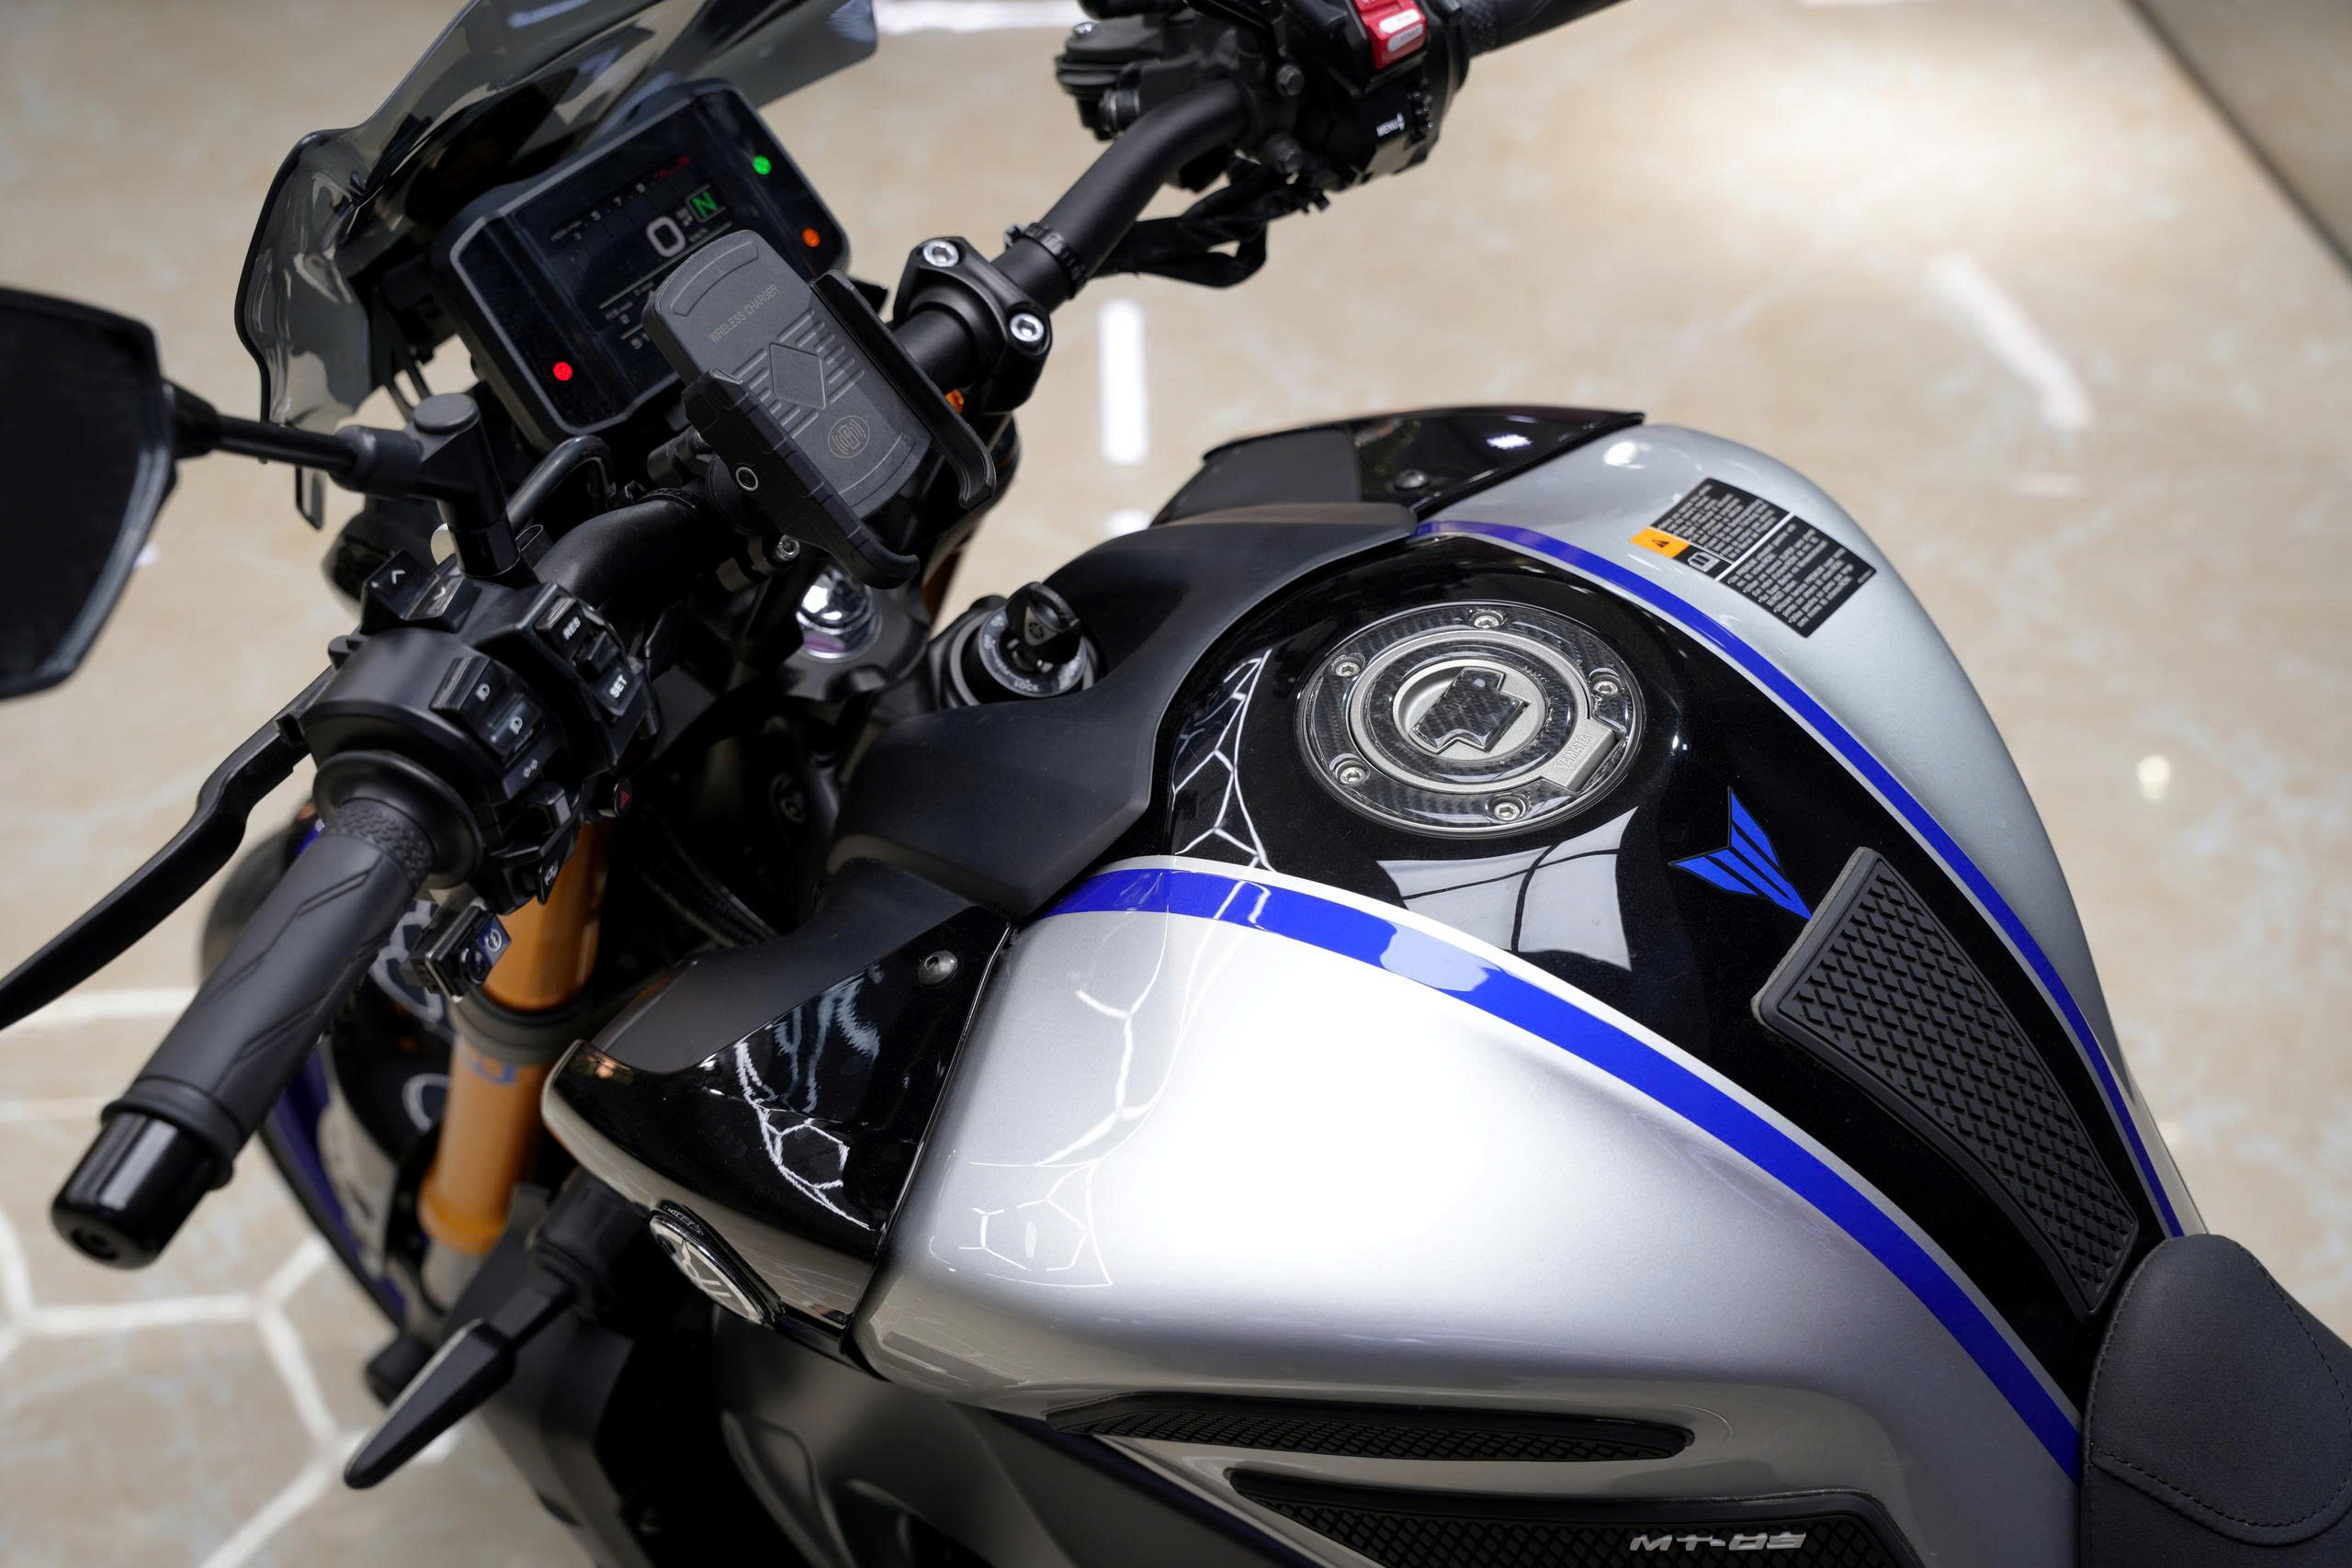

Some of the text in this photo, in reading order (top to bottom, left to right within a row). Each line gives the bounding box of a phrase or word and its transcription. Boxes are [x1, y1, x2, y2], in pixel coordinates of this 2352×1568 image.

[1375, 117, 1397, 138] MENU
[691, 189, 719, 220] N
[646, 216, 687, 258] 0
[707, 285, 780, 344] WIRELESS CHARGER
[562, 615, 582, 640] RES
[609, 673, 628, 698] SET
[1556, 732, 1595, 771] YAMAHA
[1629, 1531, 1806, 1551] MT-09
